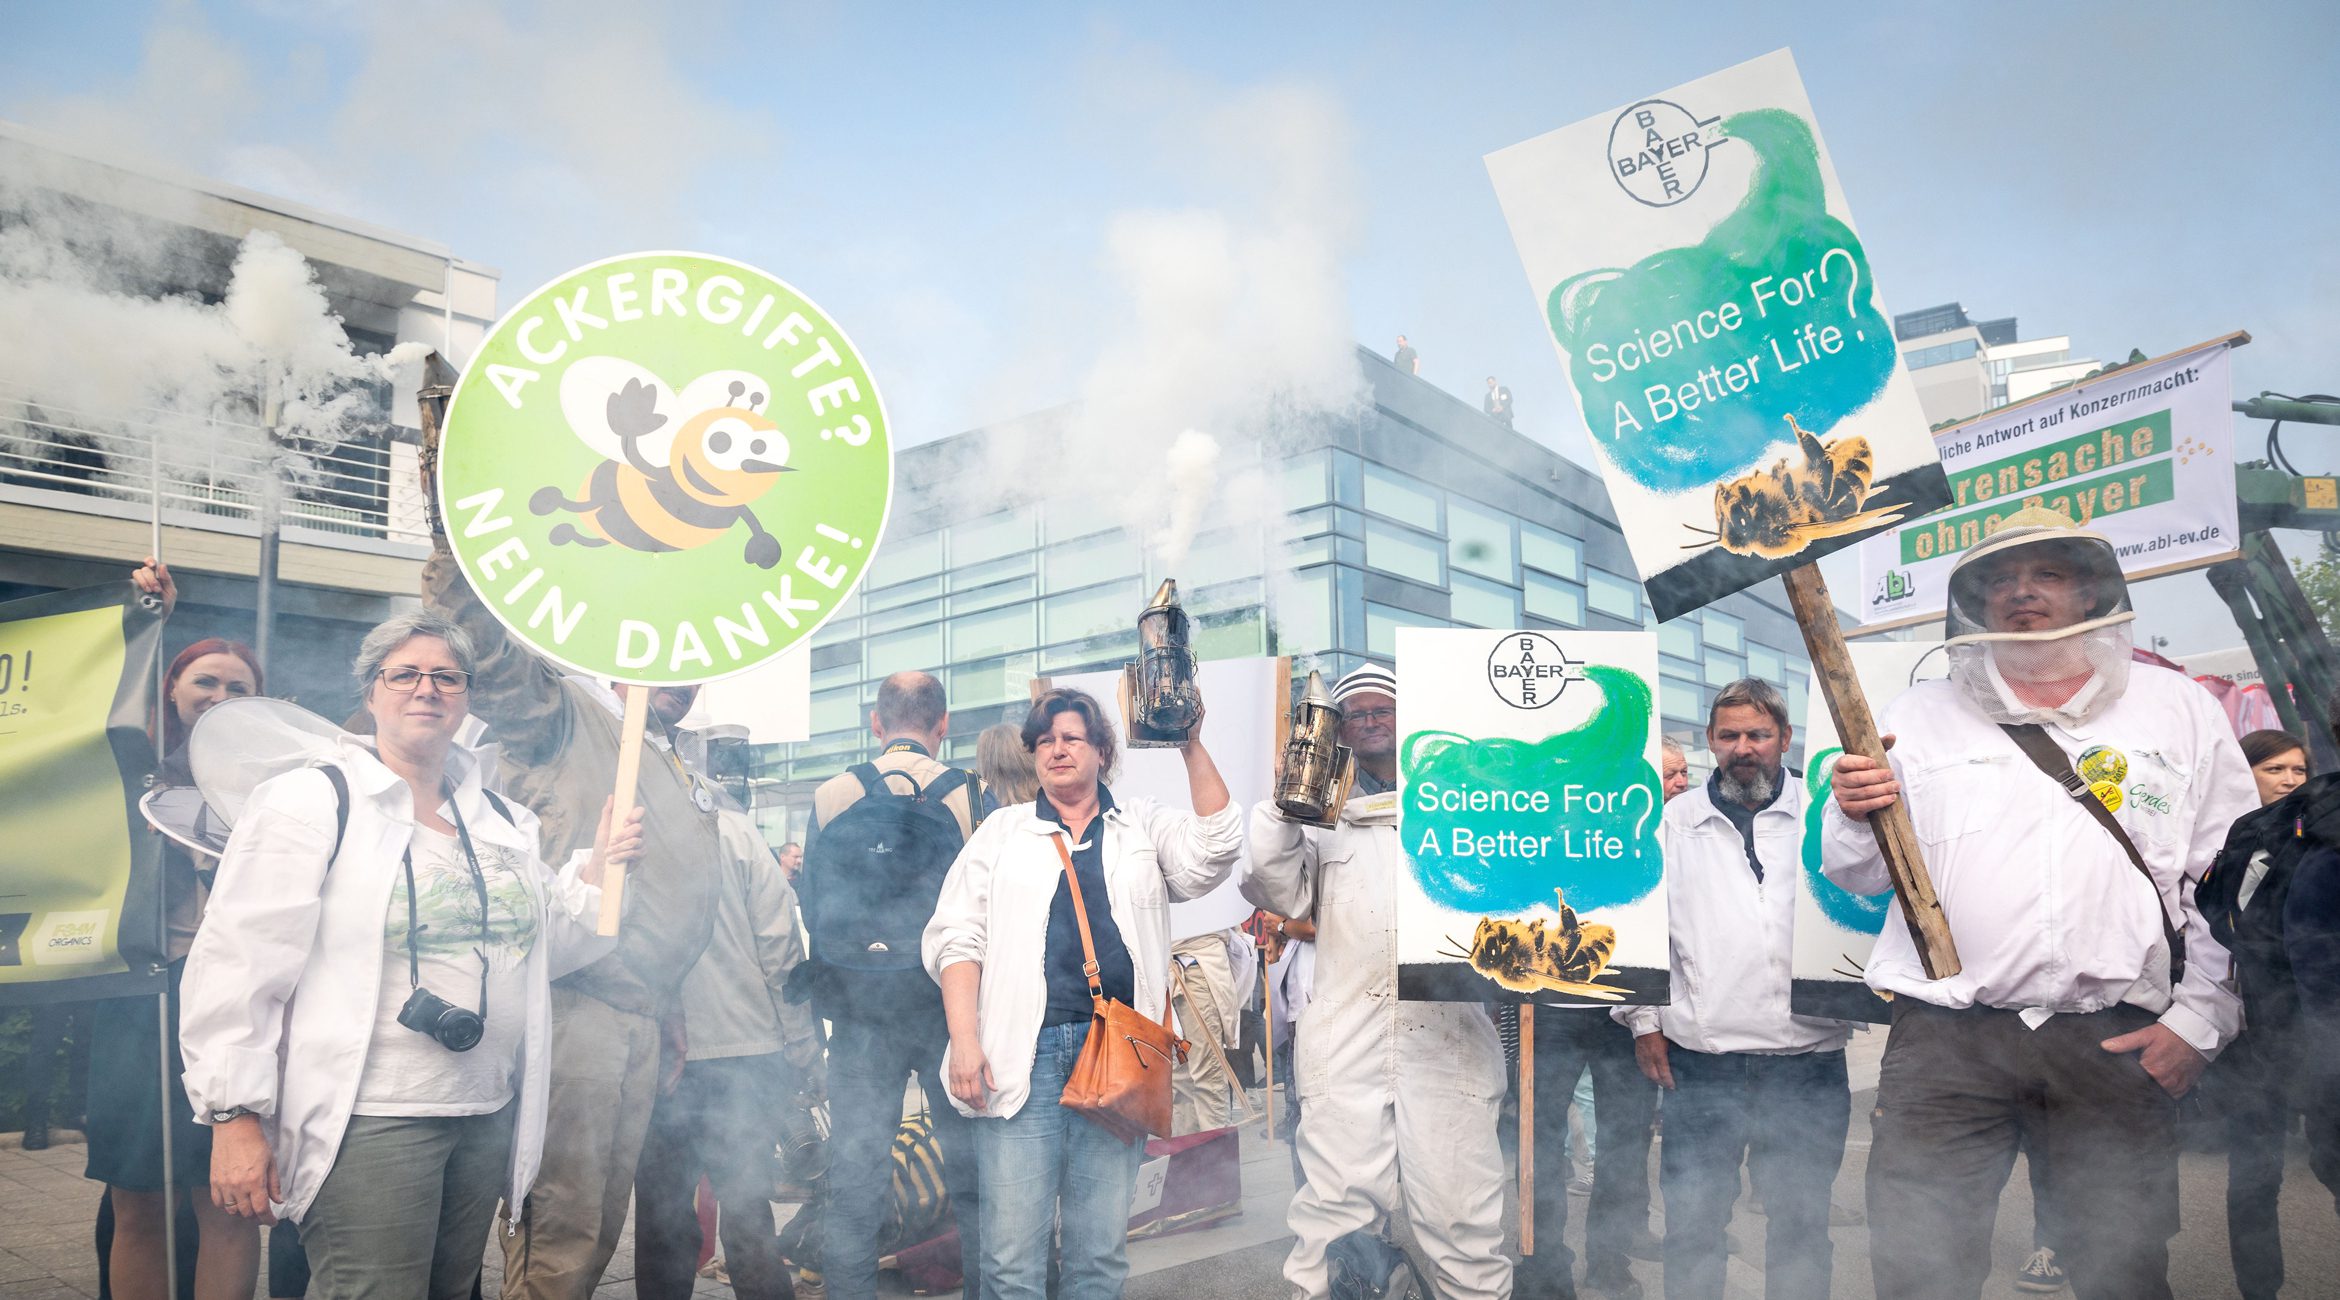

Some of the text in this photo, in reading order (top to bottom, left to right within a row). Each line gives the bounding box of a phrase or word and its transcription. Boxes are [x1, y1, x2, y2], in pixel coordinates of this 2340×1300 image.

[1617, 131, 1702, 178] BAYER
[1635, 110, 1684, 200] BAYER
[485, 267, 872, 446] ACKERGIFTE?
[1586, 301, 1743, 383] Science
[1614, 400, 1644, 440] A
[1643, 354, 1760, 424] Better
[1975, 417, 2035, 449] Antwort
[2039, 410, 2065, 431] auf
[2069, 368, 2200, 421] Konzernmacht:
[1936, 425, 2155, 513] rensache
[1915, 513, 2003, 559] ohne
[455, 487, 864, 672] NEIN DANKE!
[1493, 664, 1564, 679] BAYER
[1519, 637, 1537, 705] BAYER
[1416, 781, 1550, 813] Science
[1417, 827, 1443, 857] A
[1452, 826, 1552, 859] Better
[48, 936, 92, 948] ORGANICS
